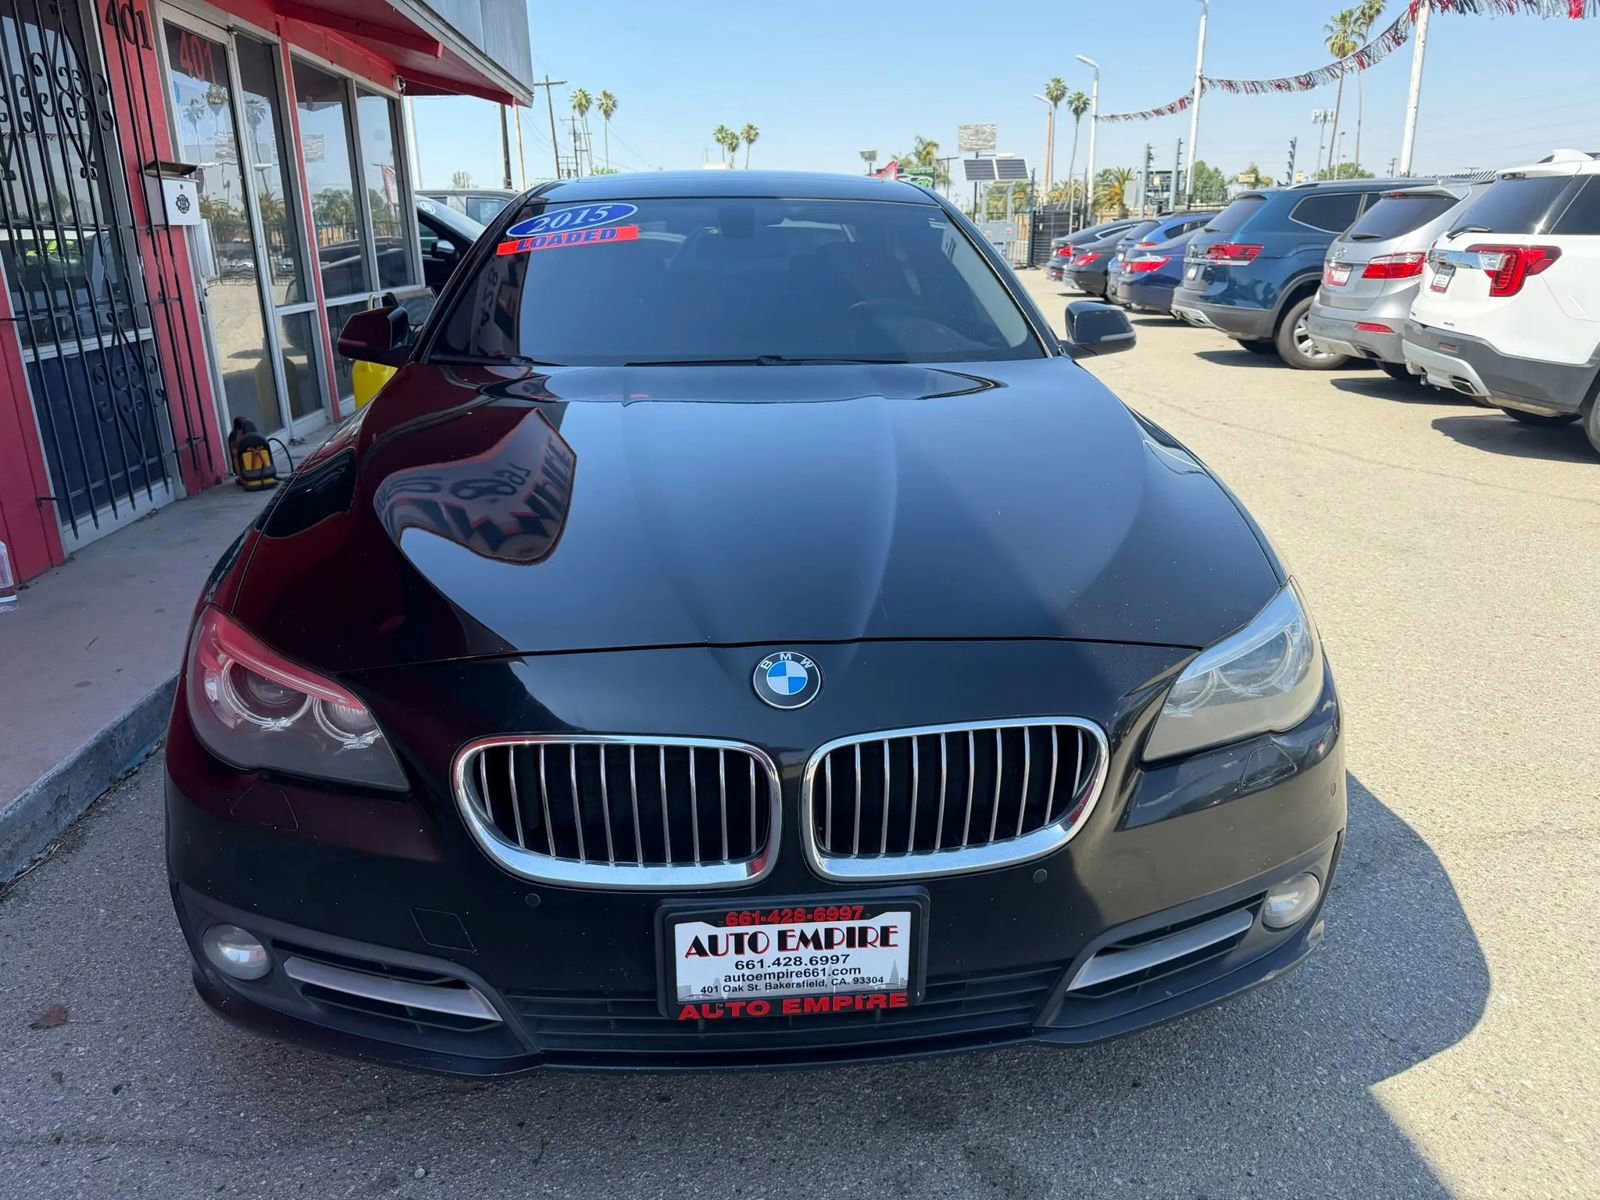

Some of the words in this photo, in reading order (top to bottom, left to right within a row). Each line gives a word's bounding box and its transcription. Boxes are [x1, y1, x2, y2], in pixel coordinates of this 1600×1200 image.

[180, 31, 216, 85] 401
[527, 205, 613, 234] 2015
[516, 228, 618, 251] LOADED
[760, 653, 814, 670] BMW
[725, 906, 864, 927] 661-428-6997
[685, 930, 770, 959] AUTO
[777, 925, 899, 952] EMPIRE
[734, 954, 850, 971] 661.428.6997
[700, 986, 719, 995] 401
[722, 983, 744, 994] Oak
[747, 982, 762, 993] St.
[764, 979, 829, 992] Bakersfield,
[831, 977, 850, 987] CA.
[853, 976, 884, 986] 93304
[723, 966, 862, 984] autoempire661.com
[678, 1002, 771, 1021] AUTO
[782, 992, 908, 1016] EMPIRE
